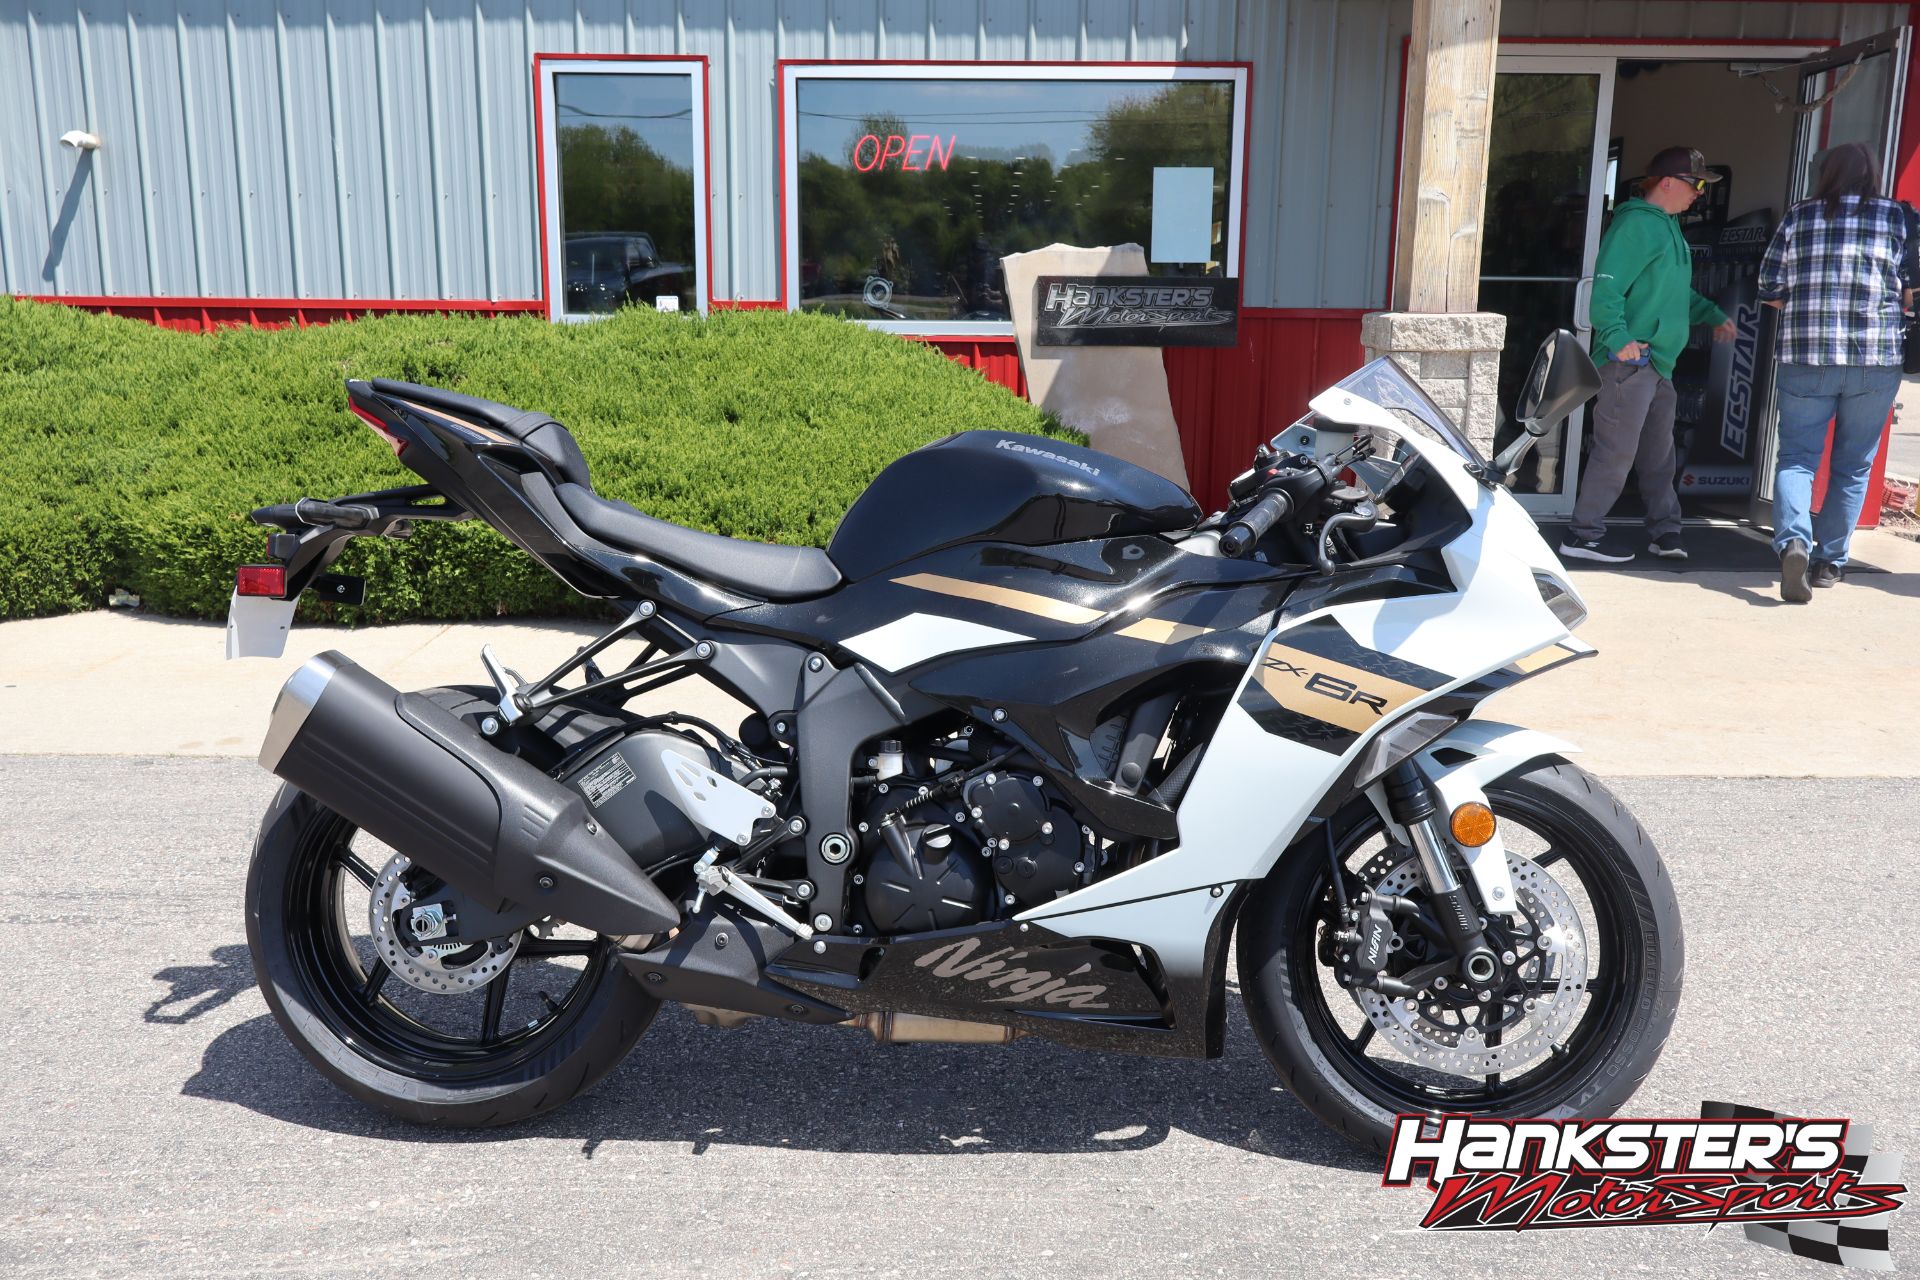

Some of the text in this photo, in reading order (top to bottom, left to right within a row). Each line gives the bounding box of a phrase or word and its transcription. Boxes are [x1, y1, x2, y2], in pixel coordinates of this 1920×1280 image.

[854, 134, 957, 172] OPEN
[1720, 303, 1762, 459] ECSTAR
[995, 439, 1101, 477] Kawasaki
[1697, 475, 1750, 486] SUZUKI
[1367, 923, 1383, 965] NISSIN
[914, 937, 1110, 1009] Ninja
